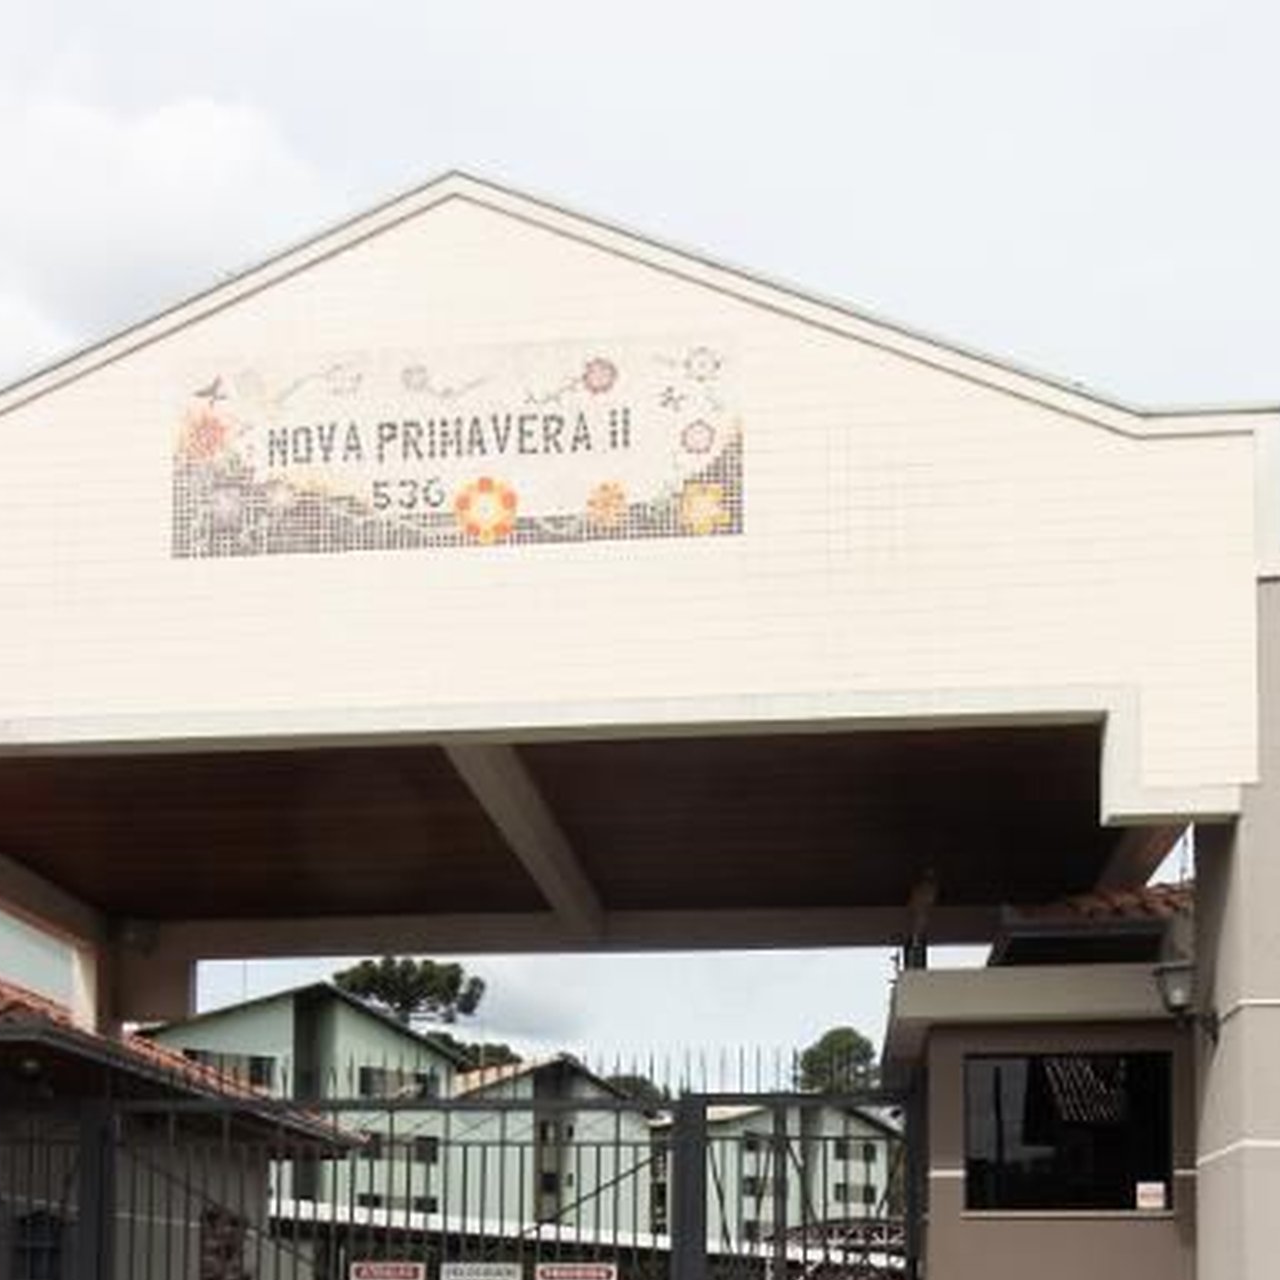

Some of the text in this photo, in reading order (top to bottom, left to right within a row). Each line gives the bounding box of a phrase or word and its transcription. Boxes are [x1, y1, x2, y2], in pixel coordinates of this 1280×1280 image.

[267, 420, 363, 467] NOVA
[376, 409, 594, 464] PRIMAVERA
[371, 478, 446, 511] 536
